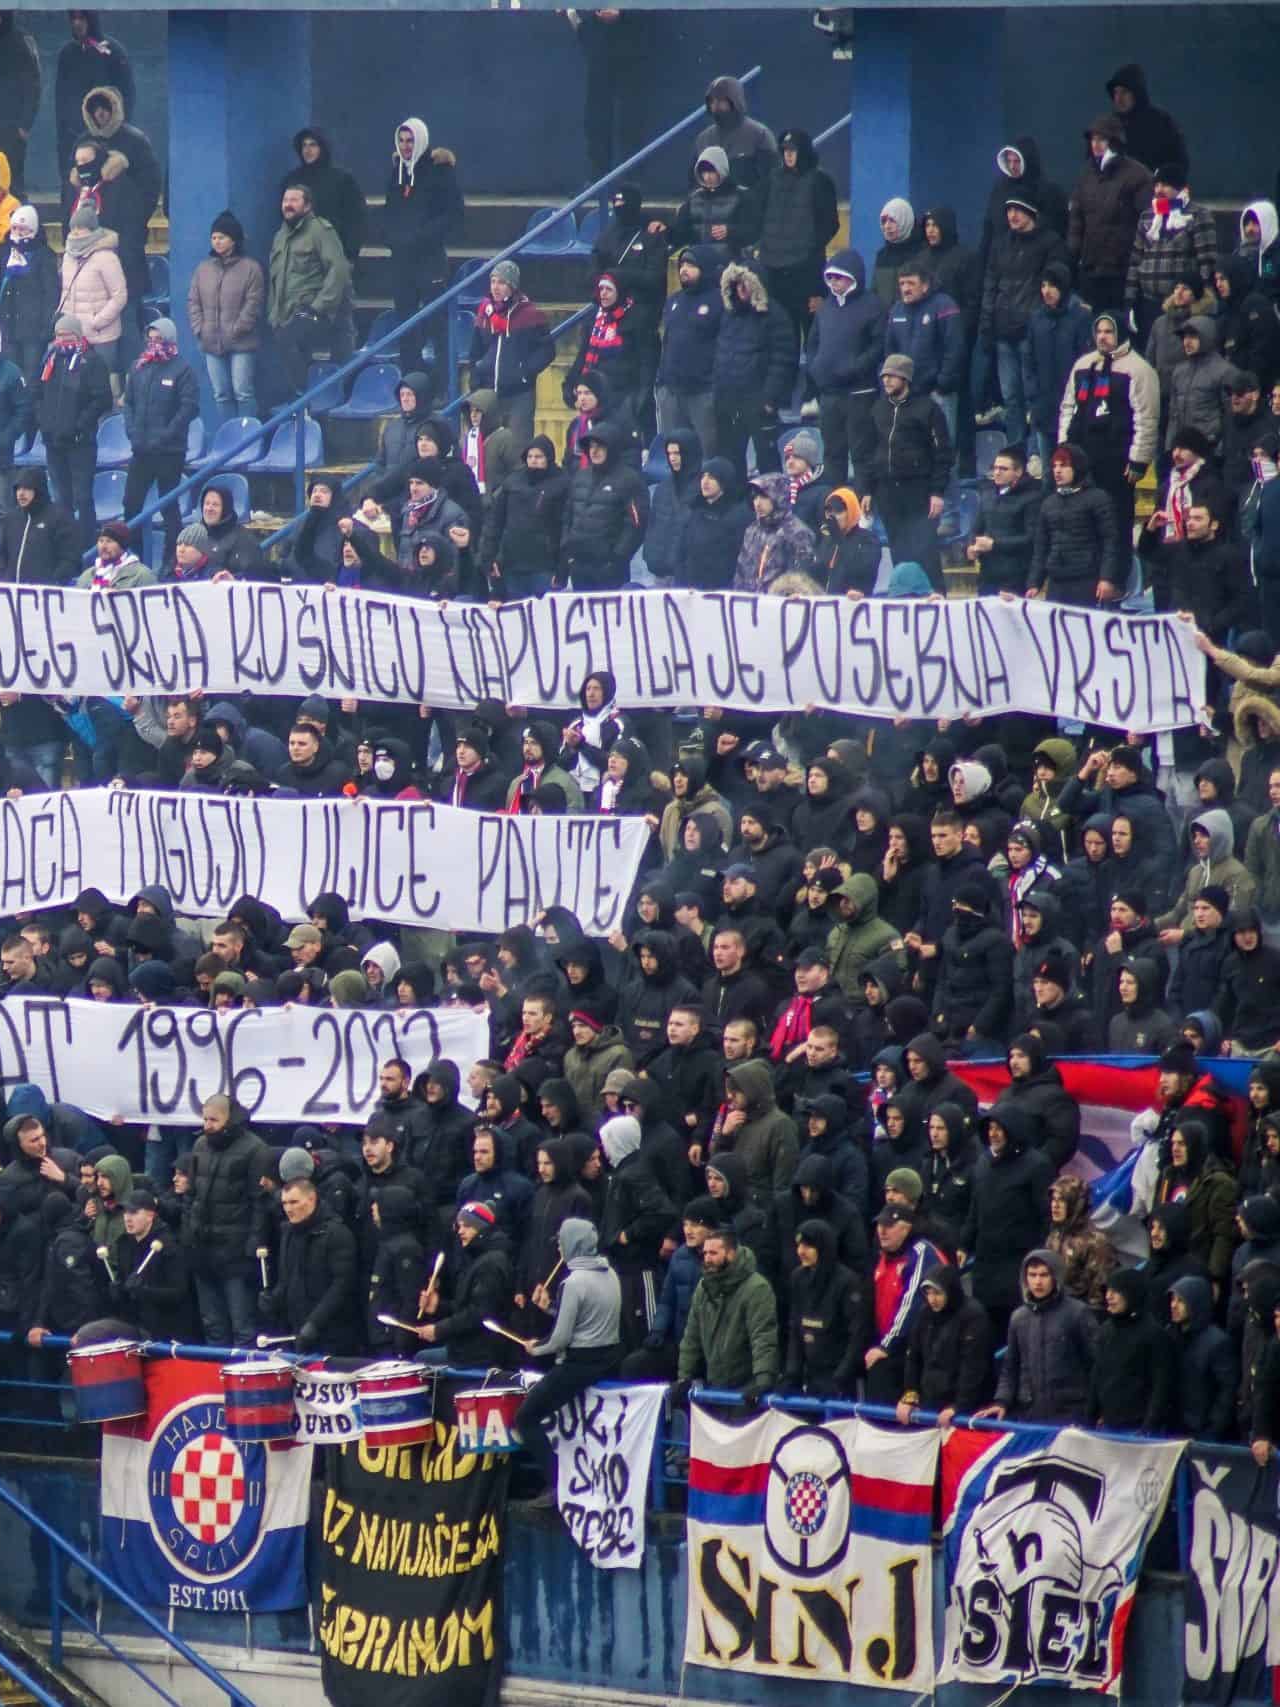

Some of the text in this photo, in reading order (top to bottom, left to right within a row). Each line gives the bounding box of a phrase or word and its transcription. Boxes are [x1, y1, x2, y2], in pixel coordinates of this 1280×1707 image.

[91, 586, 209, 692] SRCA
[232, 586, 423, 698] KOŠNICU
[439, 591, 697, 704] NAPUSTILA
[702, 594, 764, 701] JE
[779, 597, 1012, 708] POSEBNA
[1022, 601, 1199, 724] VRSTA
[300, 802, 441, 918] ULICE
[569, 1446, 630, 1504] SMO
[168, 1527, 240, 1572] SPLIT
[699, 1537, 920, 1683] SINJ
